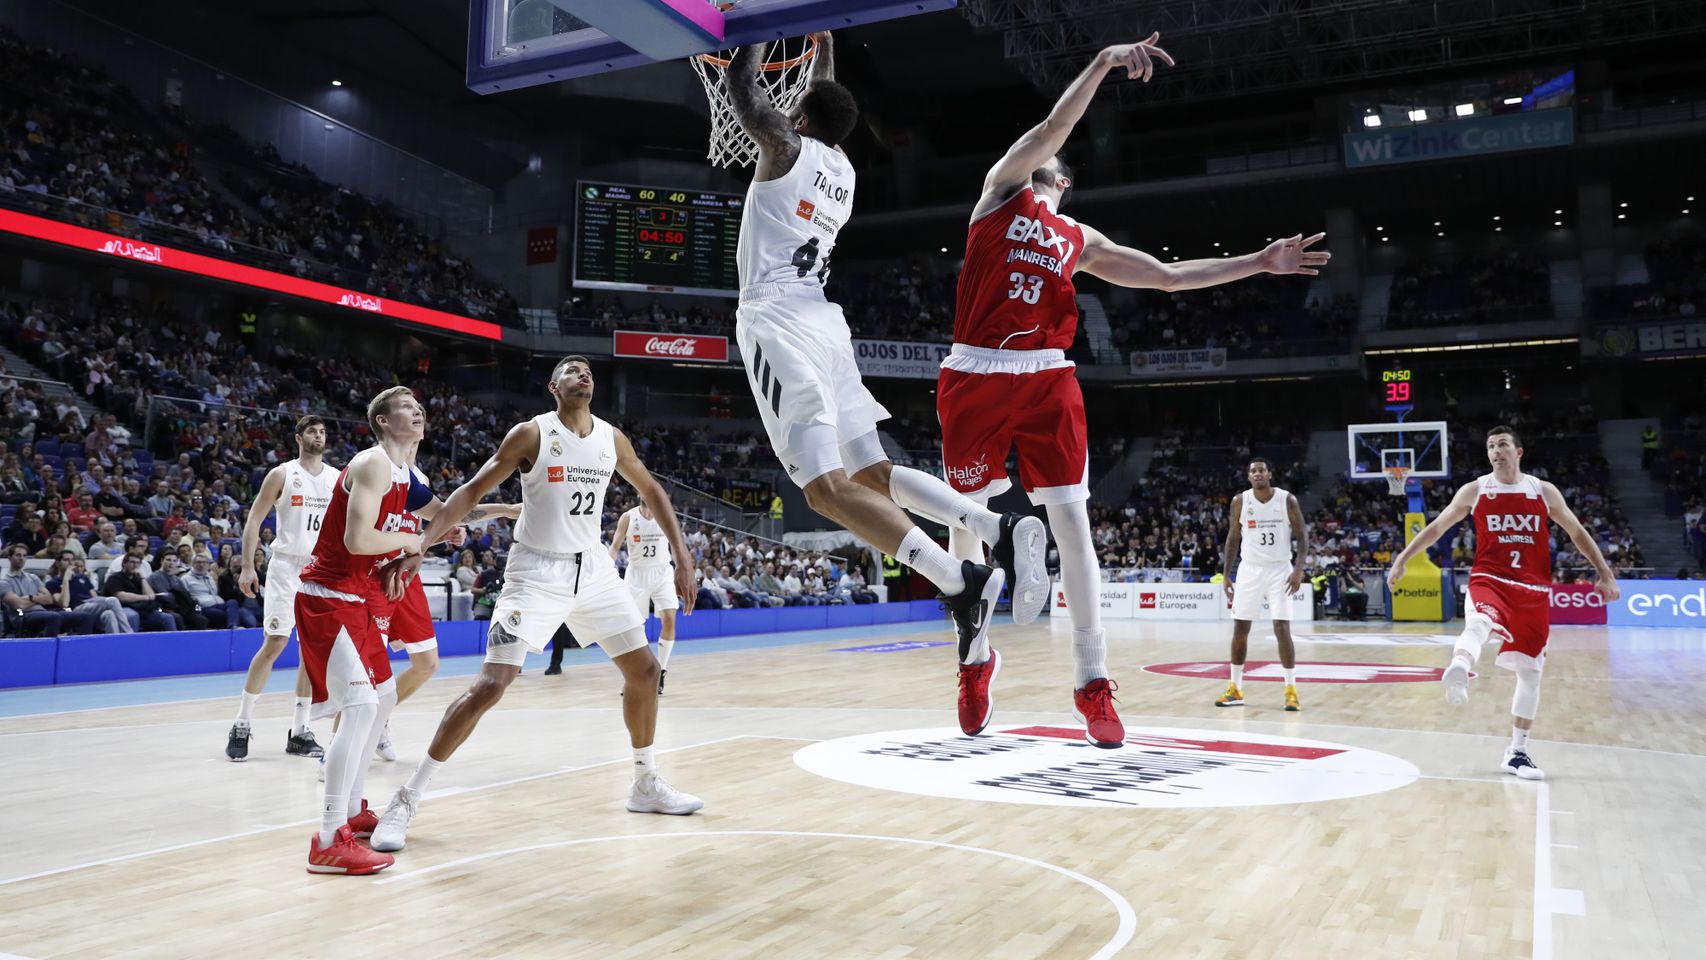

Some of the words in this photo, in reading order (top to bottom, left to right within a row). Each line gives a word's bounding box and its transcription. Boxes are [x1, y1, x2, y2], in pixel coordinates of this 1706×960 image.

[639, 190, 655, 200] 60
[669, 192, 686, 203] 40
[640, 229, 684, 244] 04:50
[1005, 214, 1075, 265] BAXI
[643, 250, 652, 260] 2
[670, 252, 678, 262] 4
[1007, 248, 1063, 278] MANRESA
[1008, 272, 1044, 305] 33
[858, 342, 898, 360] OJOS
[902, 345, 932, 361] DEL
[1382, 369, 1411, 382] 04:50
[567, 475, 600, 485] Europea
[959, 475, 983, 487] viajes
[569, 491, 596, 516] 22
[307, 513, 321, 532] 16
[1486, 514, 1541, 532] BAXI
[1260, 532, 1275, 546] 33
[1497, 534, 1535, 545] MANRESA
[643, 545, 656, 558] 23
[1510, 550, 1521, 569] 2
[1159, 592, 1214, 601] Universidad
[1403, 588, 1440, 598] betfair
[1159, 602, 1198, 610] Europea
[1627, 588, 1706, 617] end
